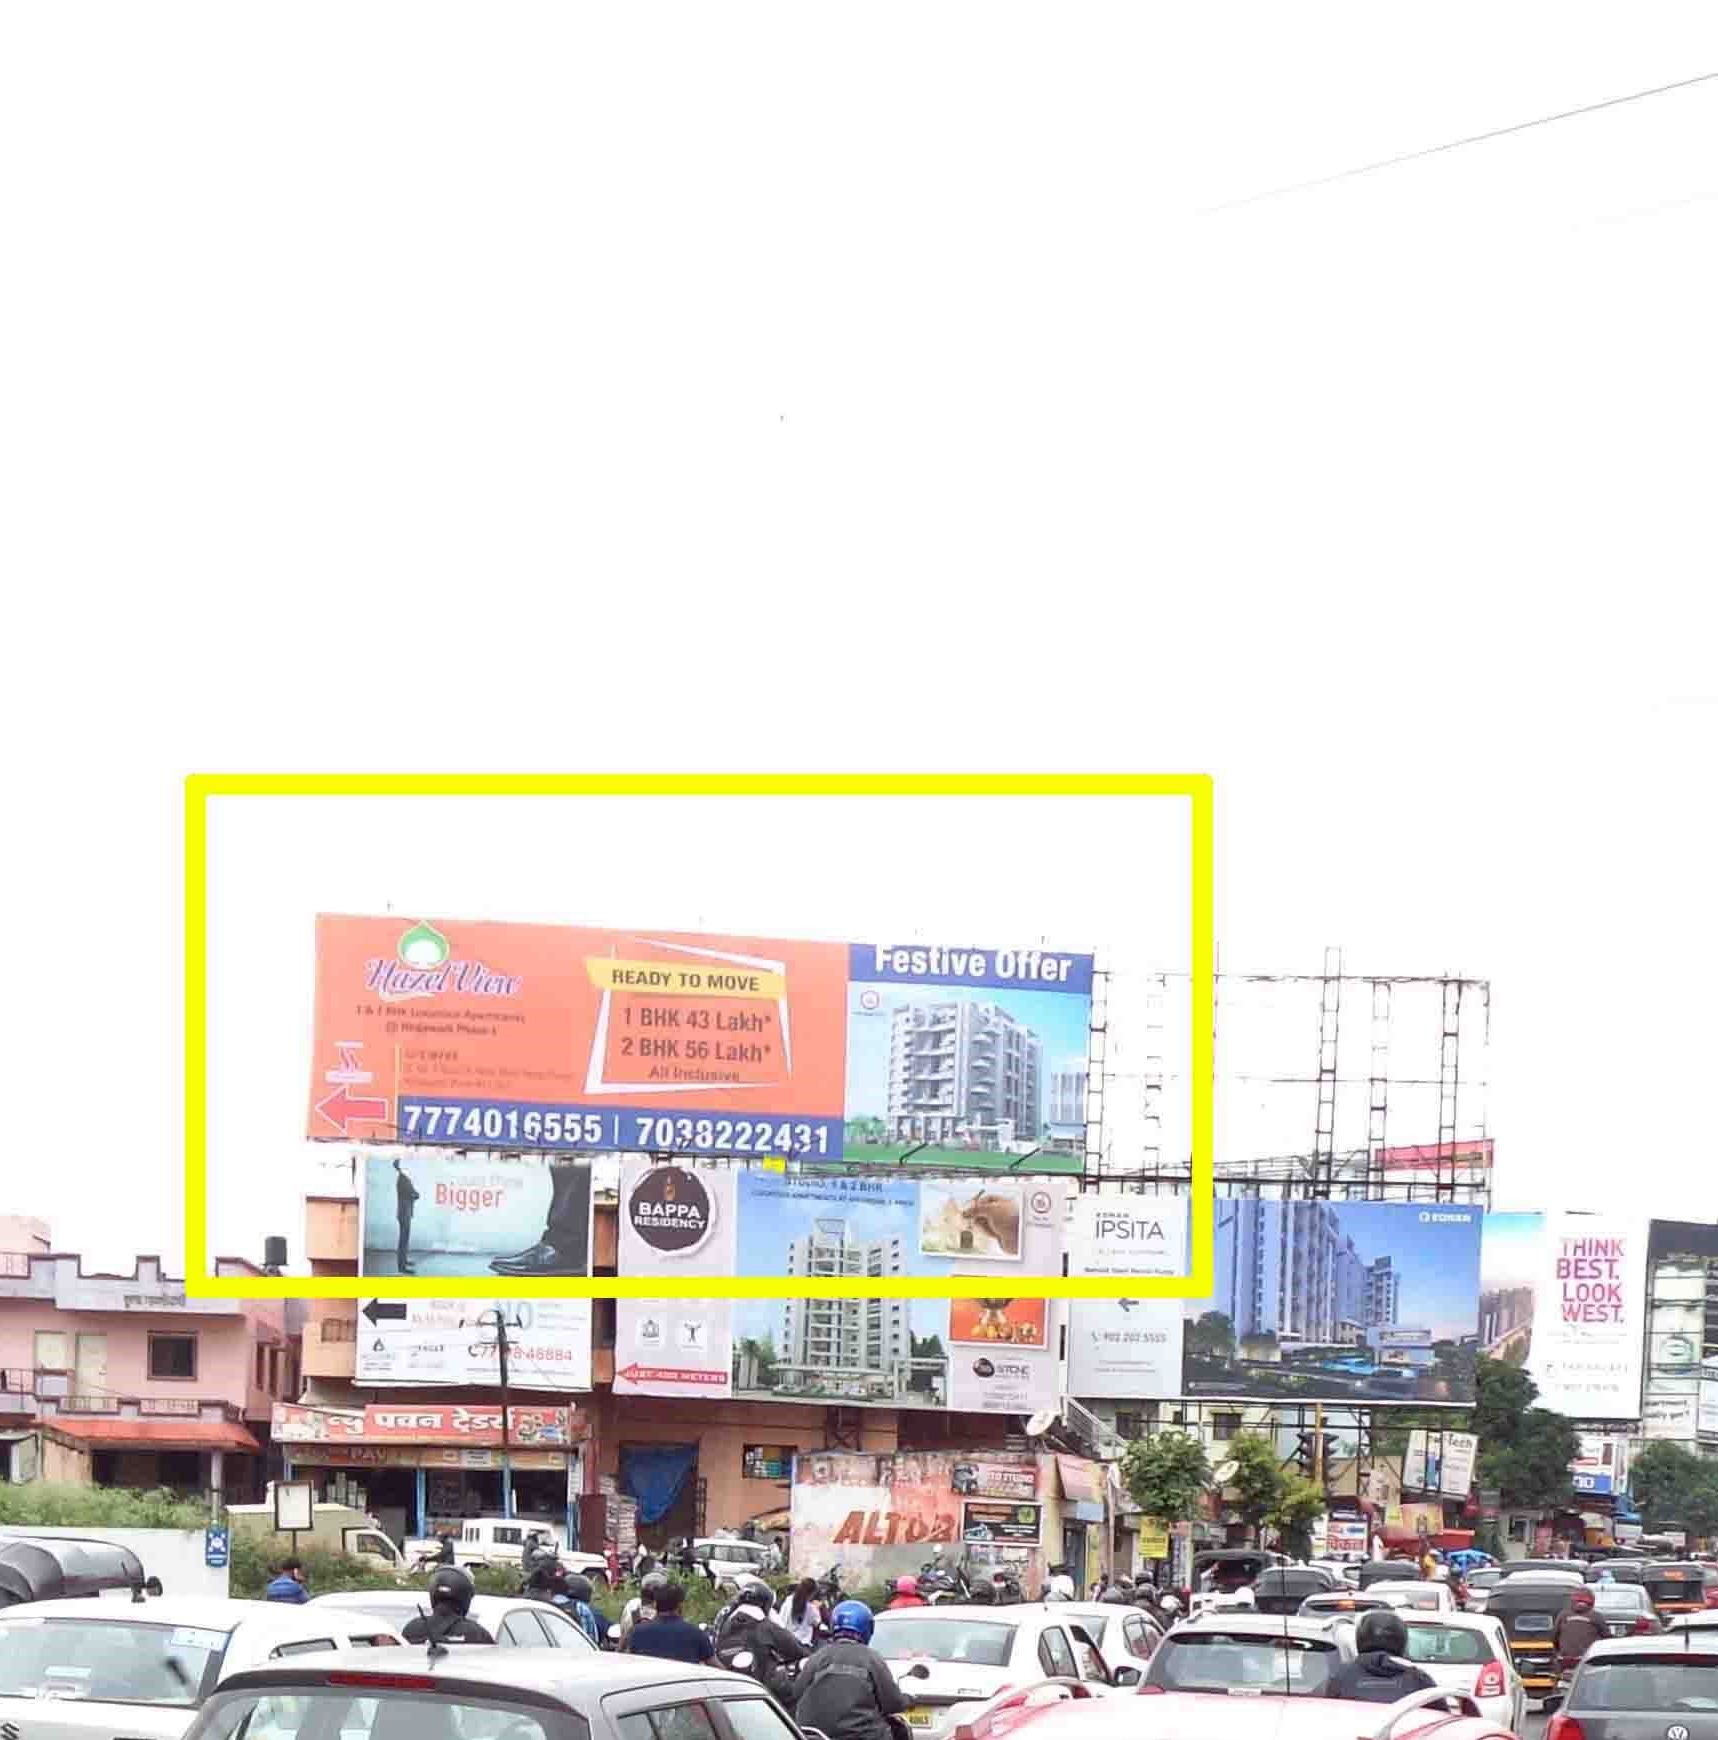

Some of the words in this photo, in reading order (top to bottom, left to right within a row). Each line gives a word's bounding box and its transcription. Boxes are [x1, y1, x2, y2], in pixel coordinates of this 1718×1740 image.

[875, 946, 986, 977] Festive
[995, 950, 1071, 982] Offer
[365, 959, 451, 1000] Hazel
[449, 958, 522, 995] View
[612, 969, 672, 987] READY
[678, 973, 701, 988] TO
[708, 975, 760, 991] MOVE
[624, 1007, 631, 1025] 1
[641, 1007, 681, 1027] BHK
[686, 1010, 710, 1030] 43
[621, 1038, 633, 1056] 2
[640, 1038, 679, 1057] BHK
[685, 1041, 709, 1060] 56
[403, 1104, 603, 1144] 7774016555
[636, 1117, 829, 1153] 7038222431
[435, 1181, 505, 1211] Bigger
[638, 1201, 701, 1219] BAPPA
[634, 1215, 706, 1230] RESIDENCY
[1095, 1220, 1165, 1241] IPSITA
[1561, 1237, 1625, 1257] THINK
[1556, 1258, 1620, 1280] BEST.
[1562, 1282, 1623, 1302] LOOK
[1561, 1303, 1625, 1324] WEST.
